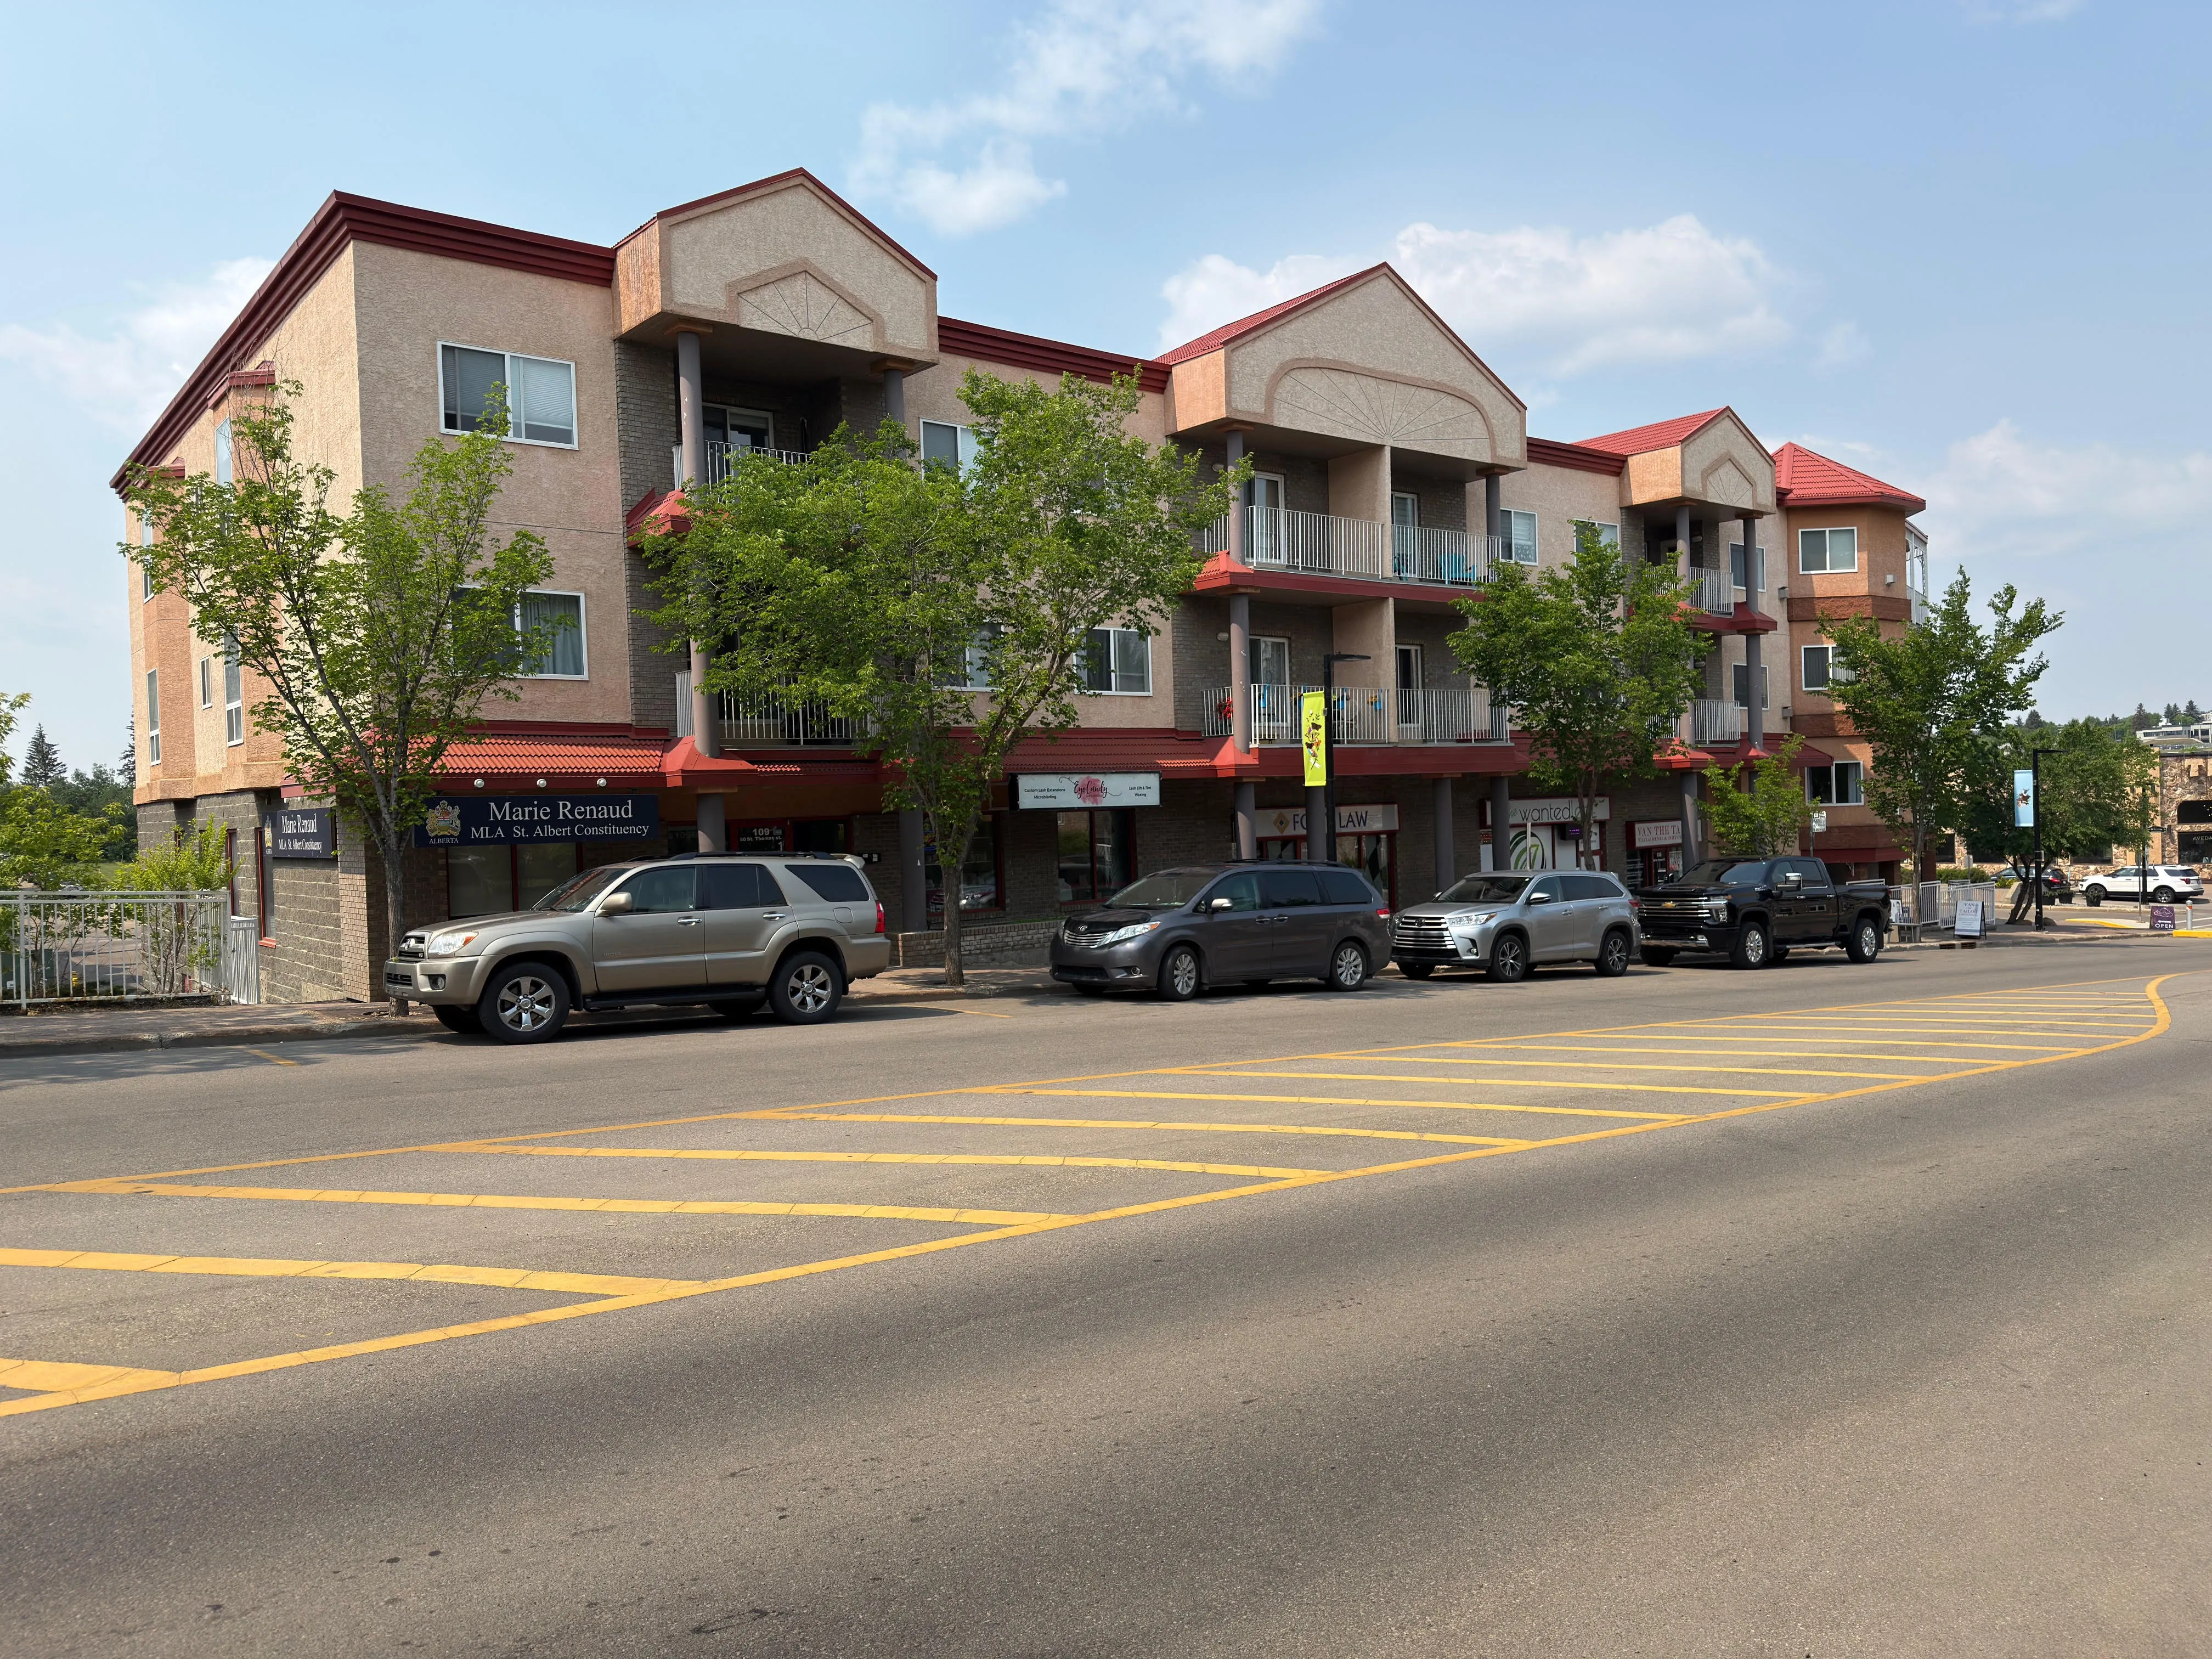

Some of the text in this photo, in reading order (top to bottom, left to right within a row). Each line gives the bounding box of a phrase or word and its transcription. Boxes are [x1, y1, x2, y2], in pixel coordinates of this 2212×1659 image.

[488, 799, 633, 821] Marie Renaud
[281, 813, 317, 833] Marie Renaud
[1339, 810, 1368, 829] LAW
[471, 823, 649, 839] MLA St. Albert Constituency
[752, 828, 770, 836] 109
[1638, 826, 1651, 837] VAN
[1654, 825, 1669, 836] THE
[292, 838, 302, 850] Albert
[302, 838, 322, 853] Constituency
